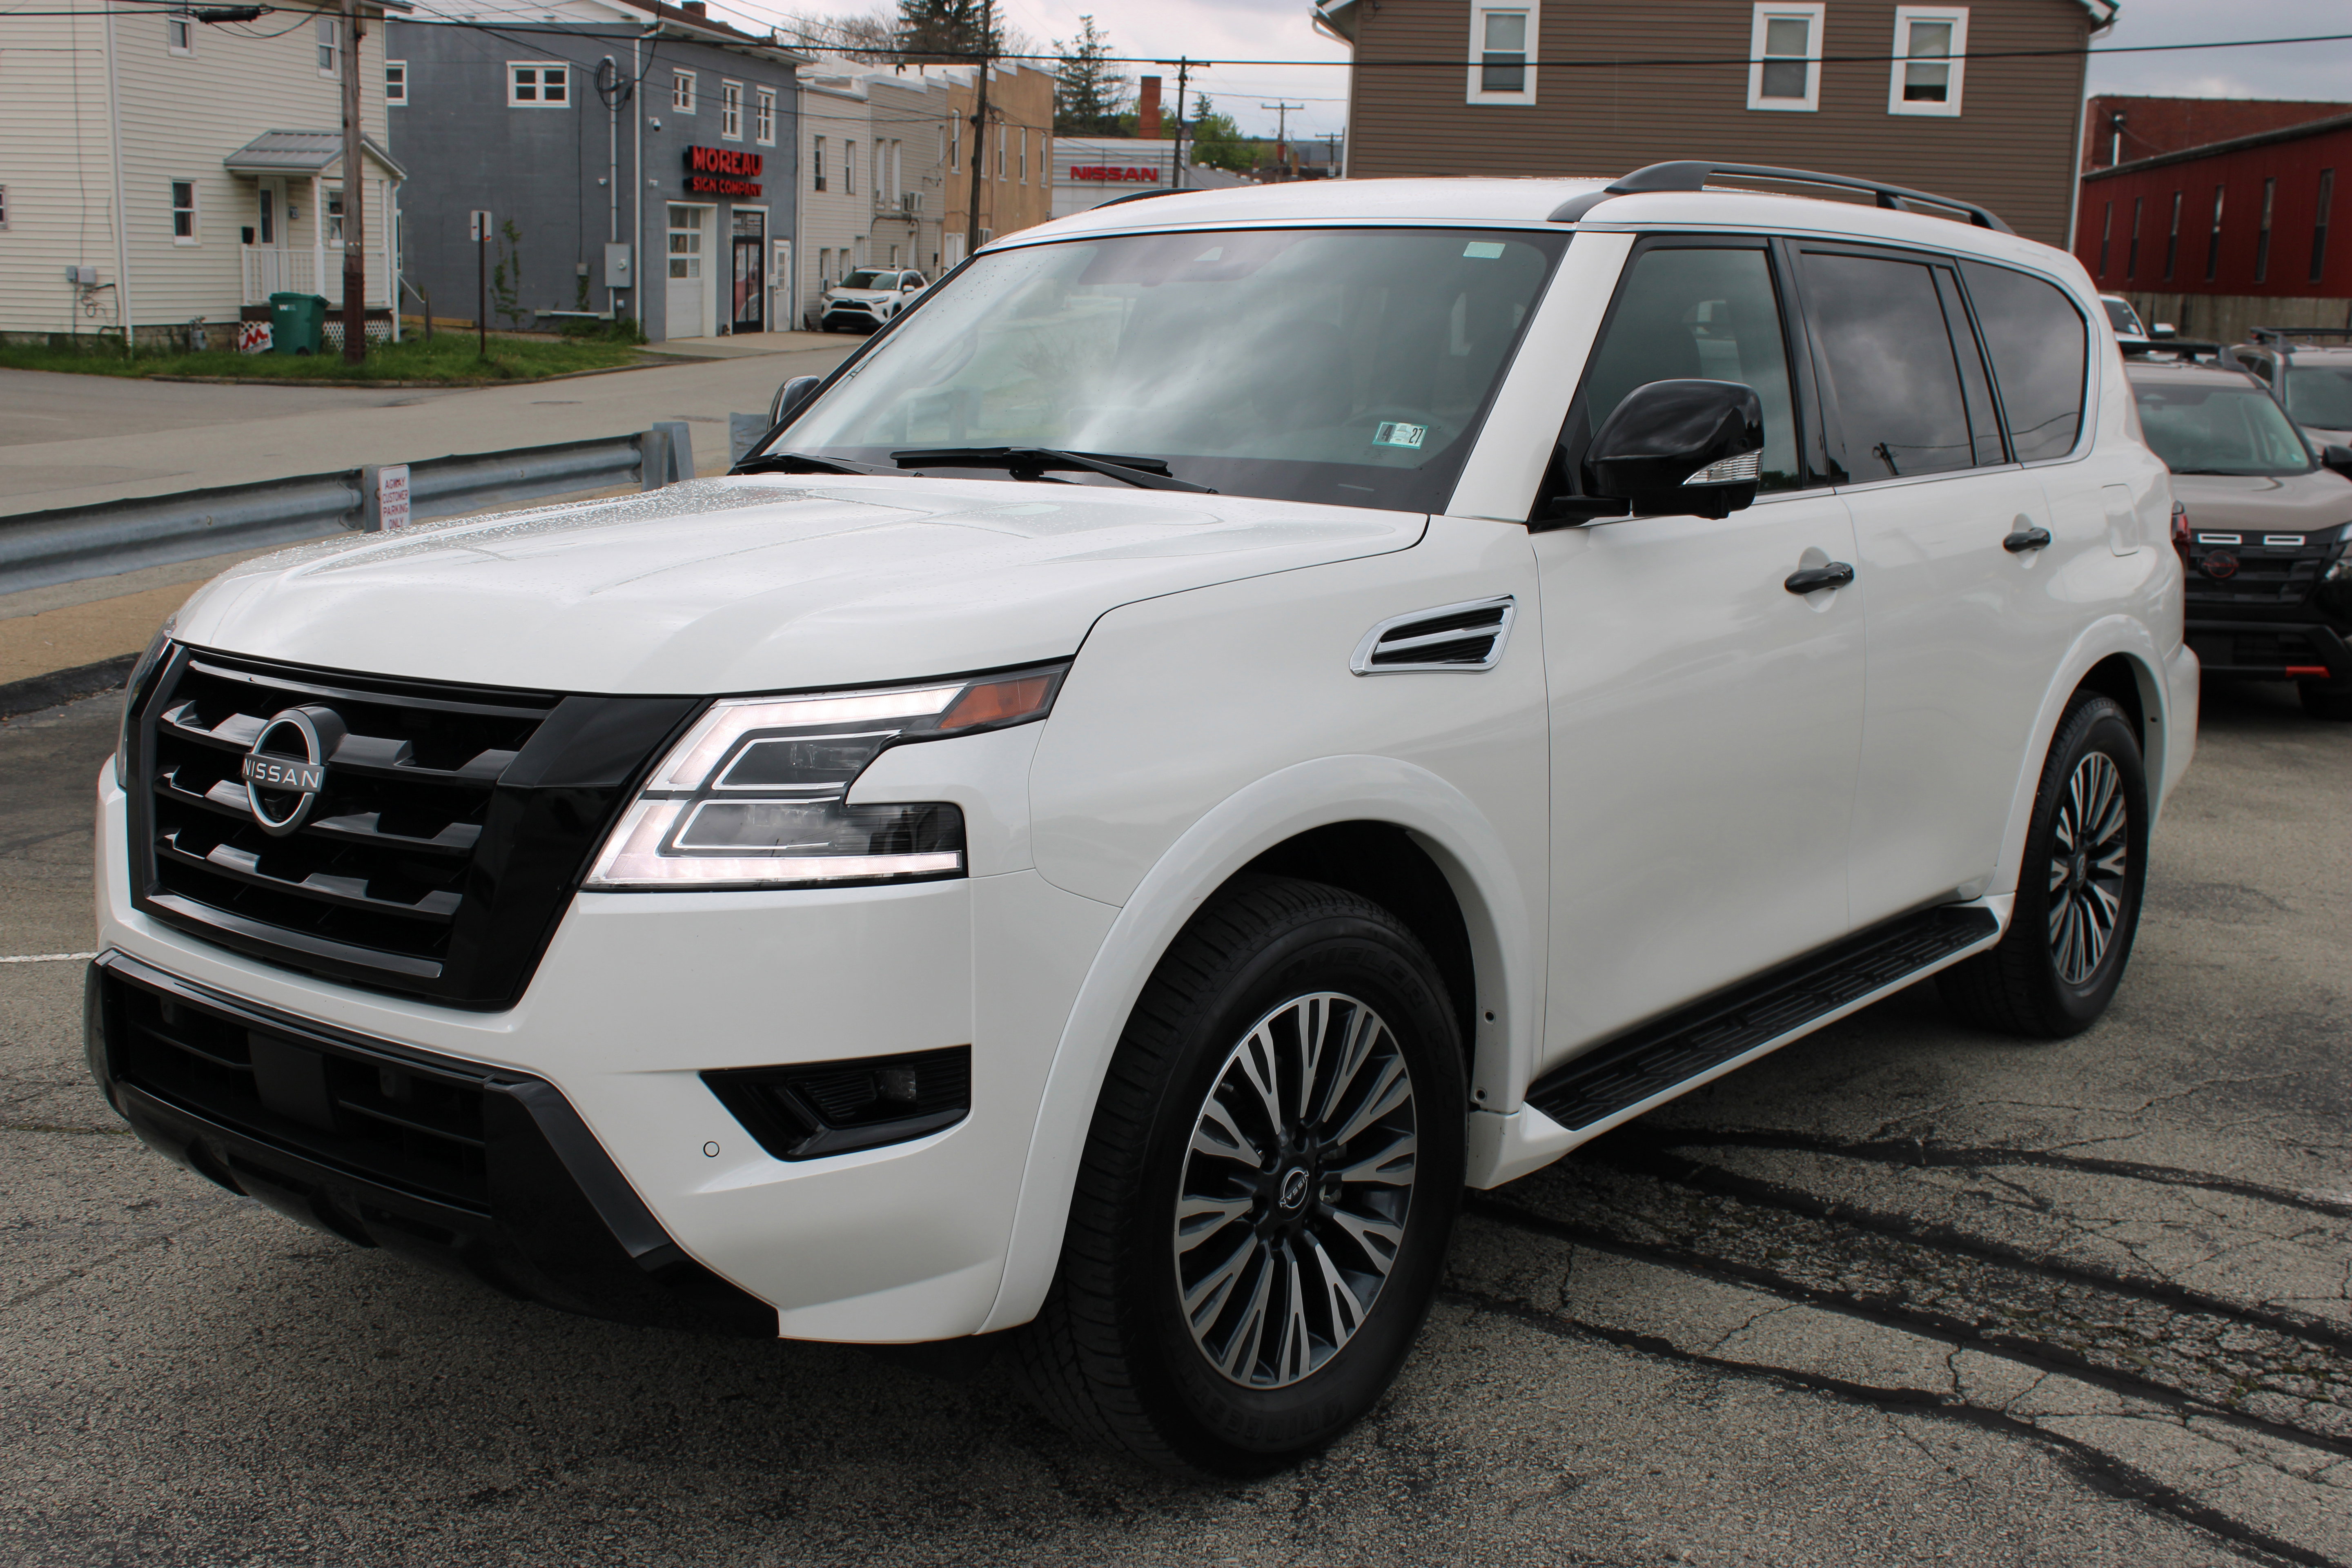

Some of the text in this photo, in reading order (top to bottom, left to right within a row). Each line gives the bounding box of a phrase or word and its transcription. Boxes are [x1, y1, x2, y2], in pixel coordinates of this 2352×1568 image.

[693, 145, 763, 177] MOREAU
[1070, 166, 1157, 181] NISSAN
[693, 176, 763, 197] SIGN COMPANY
[1383, 424, 1424, 445] 4 27
[385, 477, 405, 490] AGWAY
[383, 490, 408, 504] CUSTOMER
[383, 503, 408, 517] PARKING
[389, 517, 403, 529] ONLY
[243, 758, 320, 788] NISSAN
[1279, 1170, 1309, 1207] NISSAN
